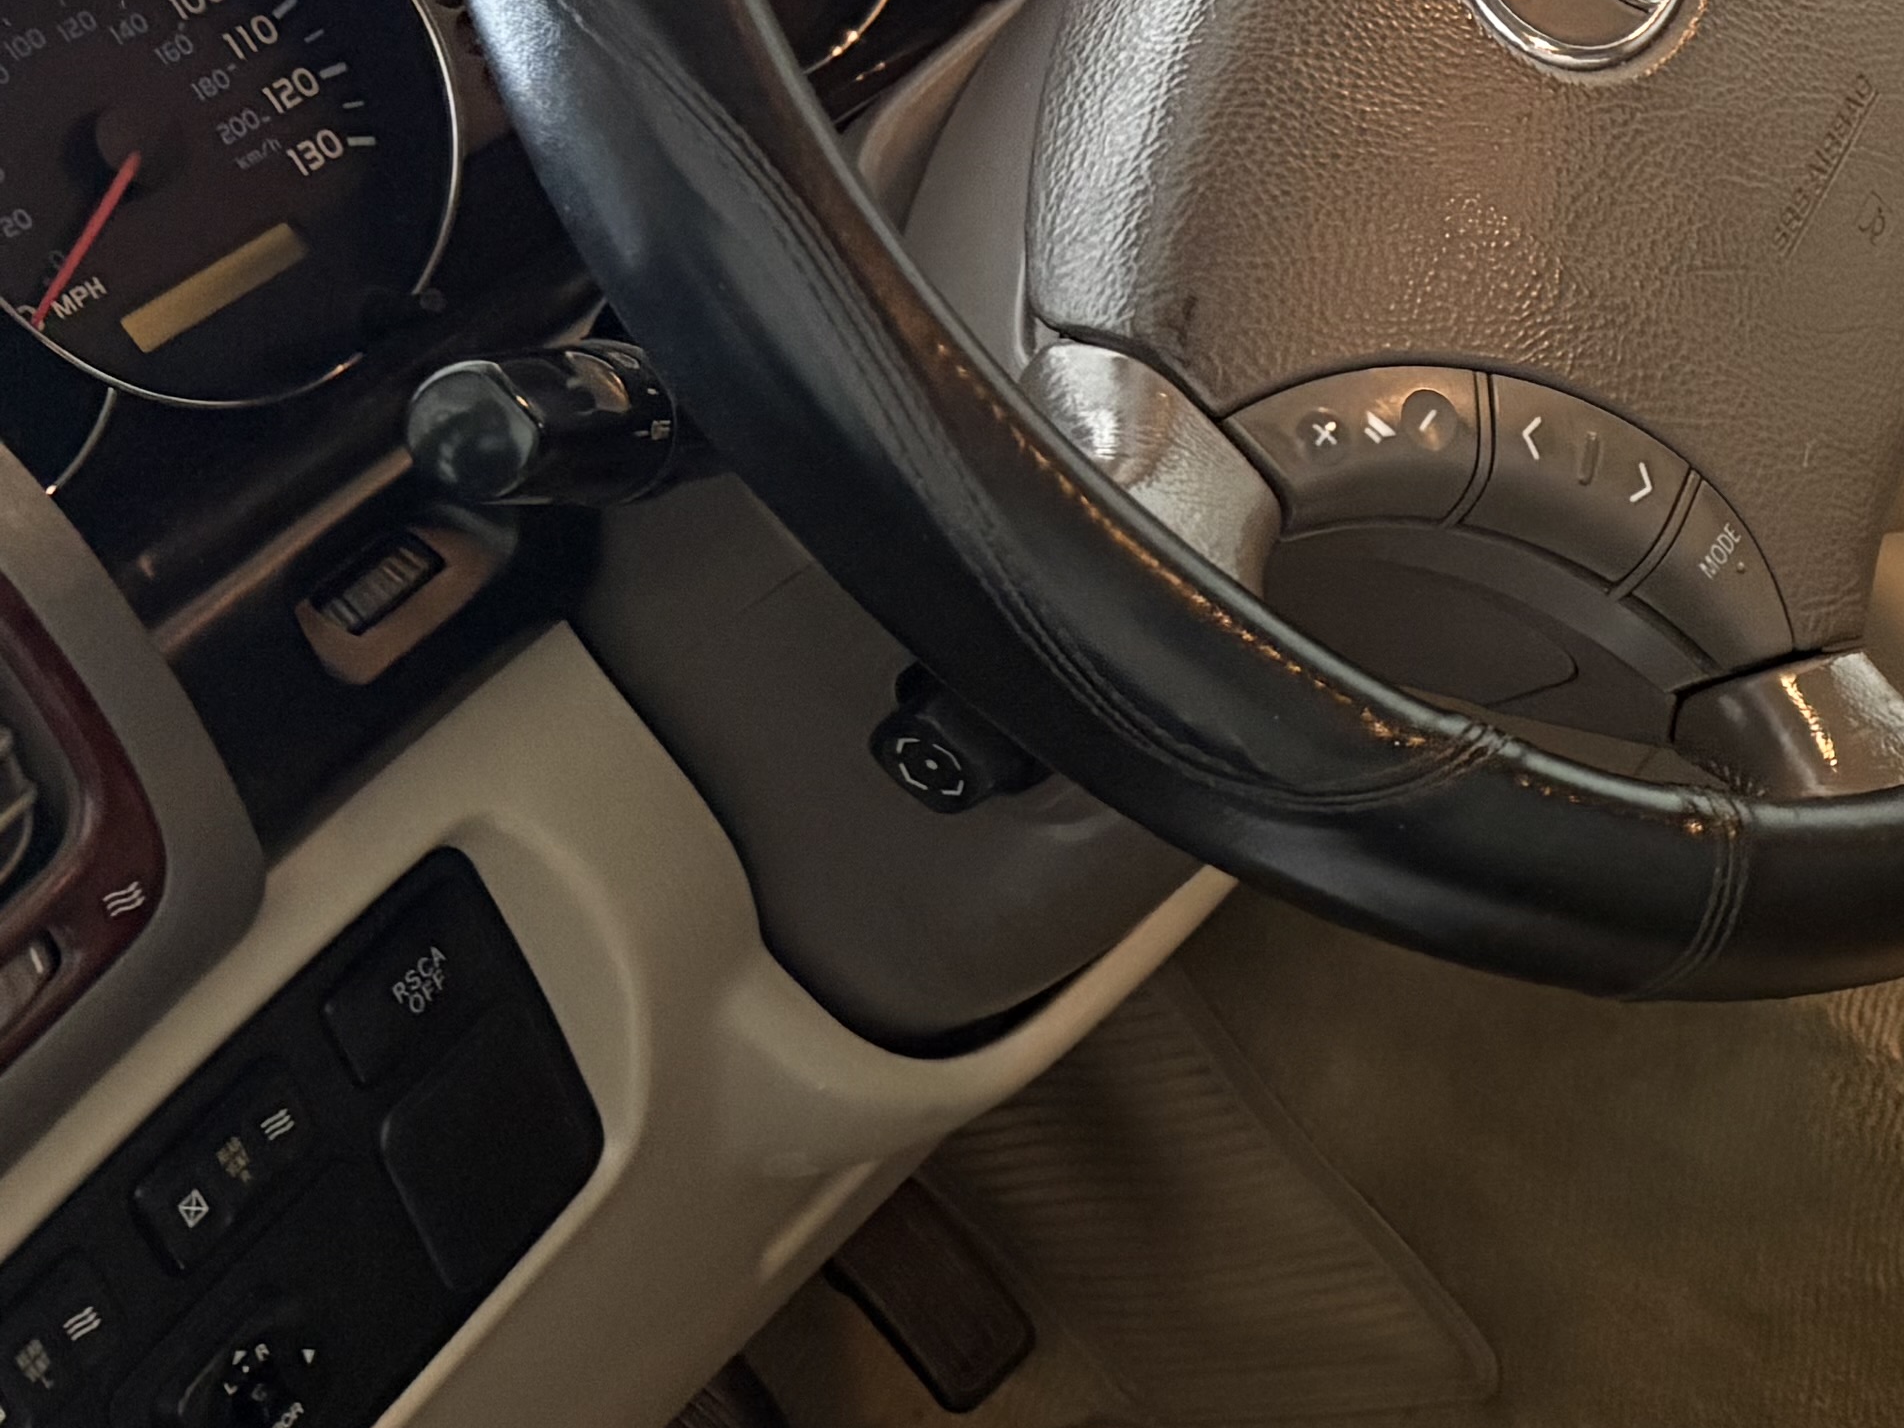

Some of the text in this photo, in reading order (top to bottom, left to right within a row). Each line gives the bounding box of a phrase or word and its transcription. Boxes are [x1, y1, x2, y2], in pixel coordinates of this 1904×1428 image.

[4, 28, 46, 61] 100
[57, 11, 97, 43] 120
[109, 13, 148, 45] 140
[222, 14, 278, 60] 110
[154, 33, 194, 66] 160
[191, 69, 230, 102] 180
[262, 67, 320, 113] 120
[216, 108, 259, 145] 200
[236, 138, 281, 170] km/h
[286, 128, 344, 176] 130
[1, 209, 32, 238] 20
[51, 276, 107, 319] MPH
[1699, 522, 1741, 580] MODE
[392, 946, 447, 1004] RSCA
[409, 968, 445, 1014] OFF
